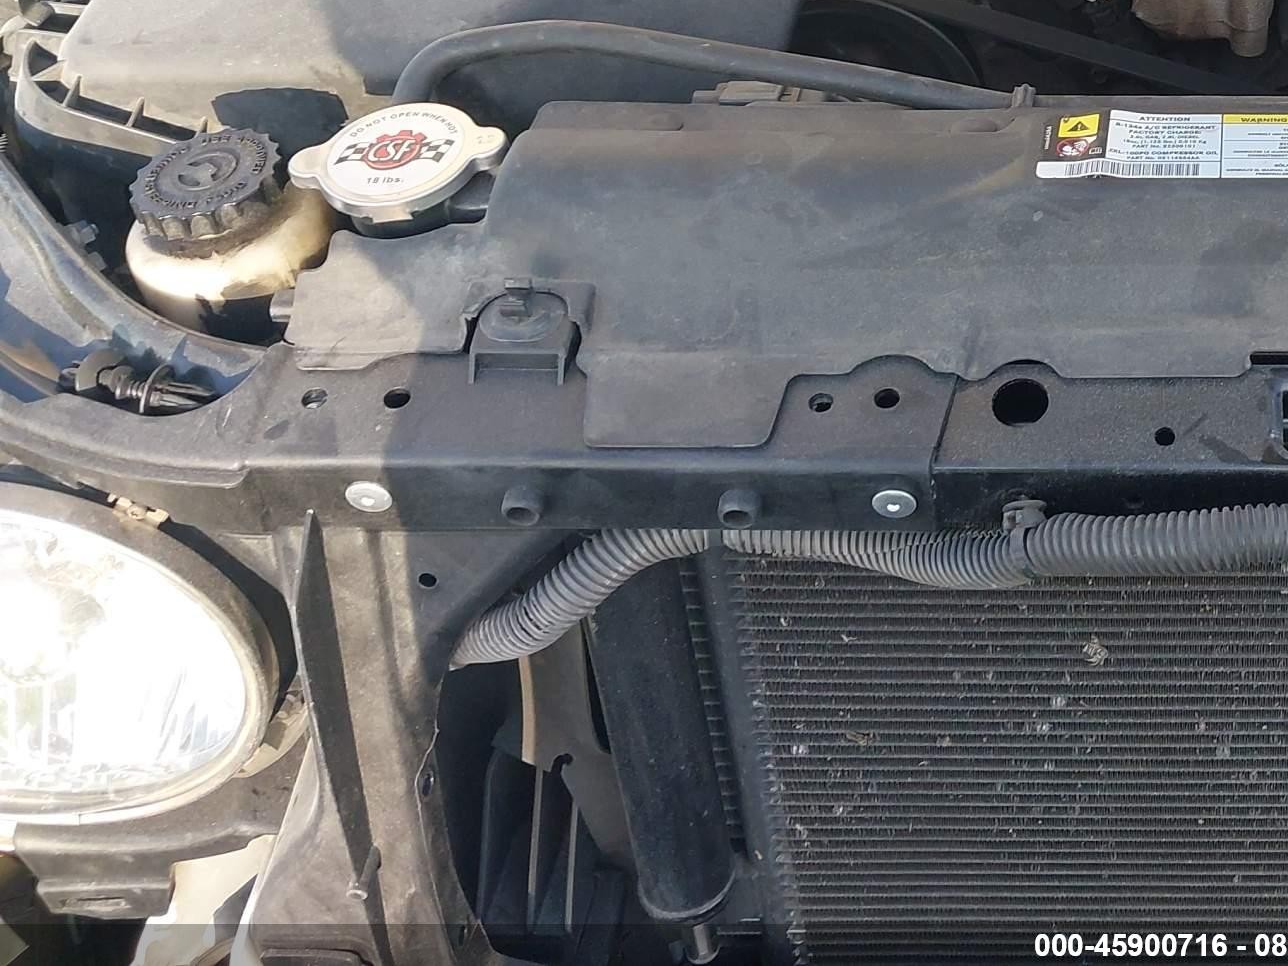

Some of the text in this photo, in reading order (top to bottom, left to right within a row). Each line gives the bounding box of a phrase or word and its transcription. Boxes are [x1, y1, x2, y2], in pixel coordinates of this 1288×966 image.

[349, 110, 459, 138] DO NOT OPEN WHEN HOT
[367, 138, 418, 162] CSF
